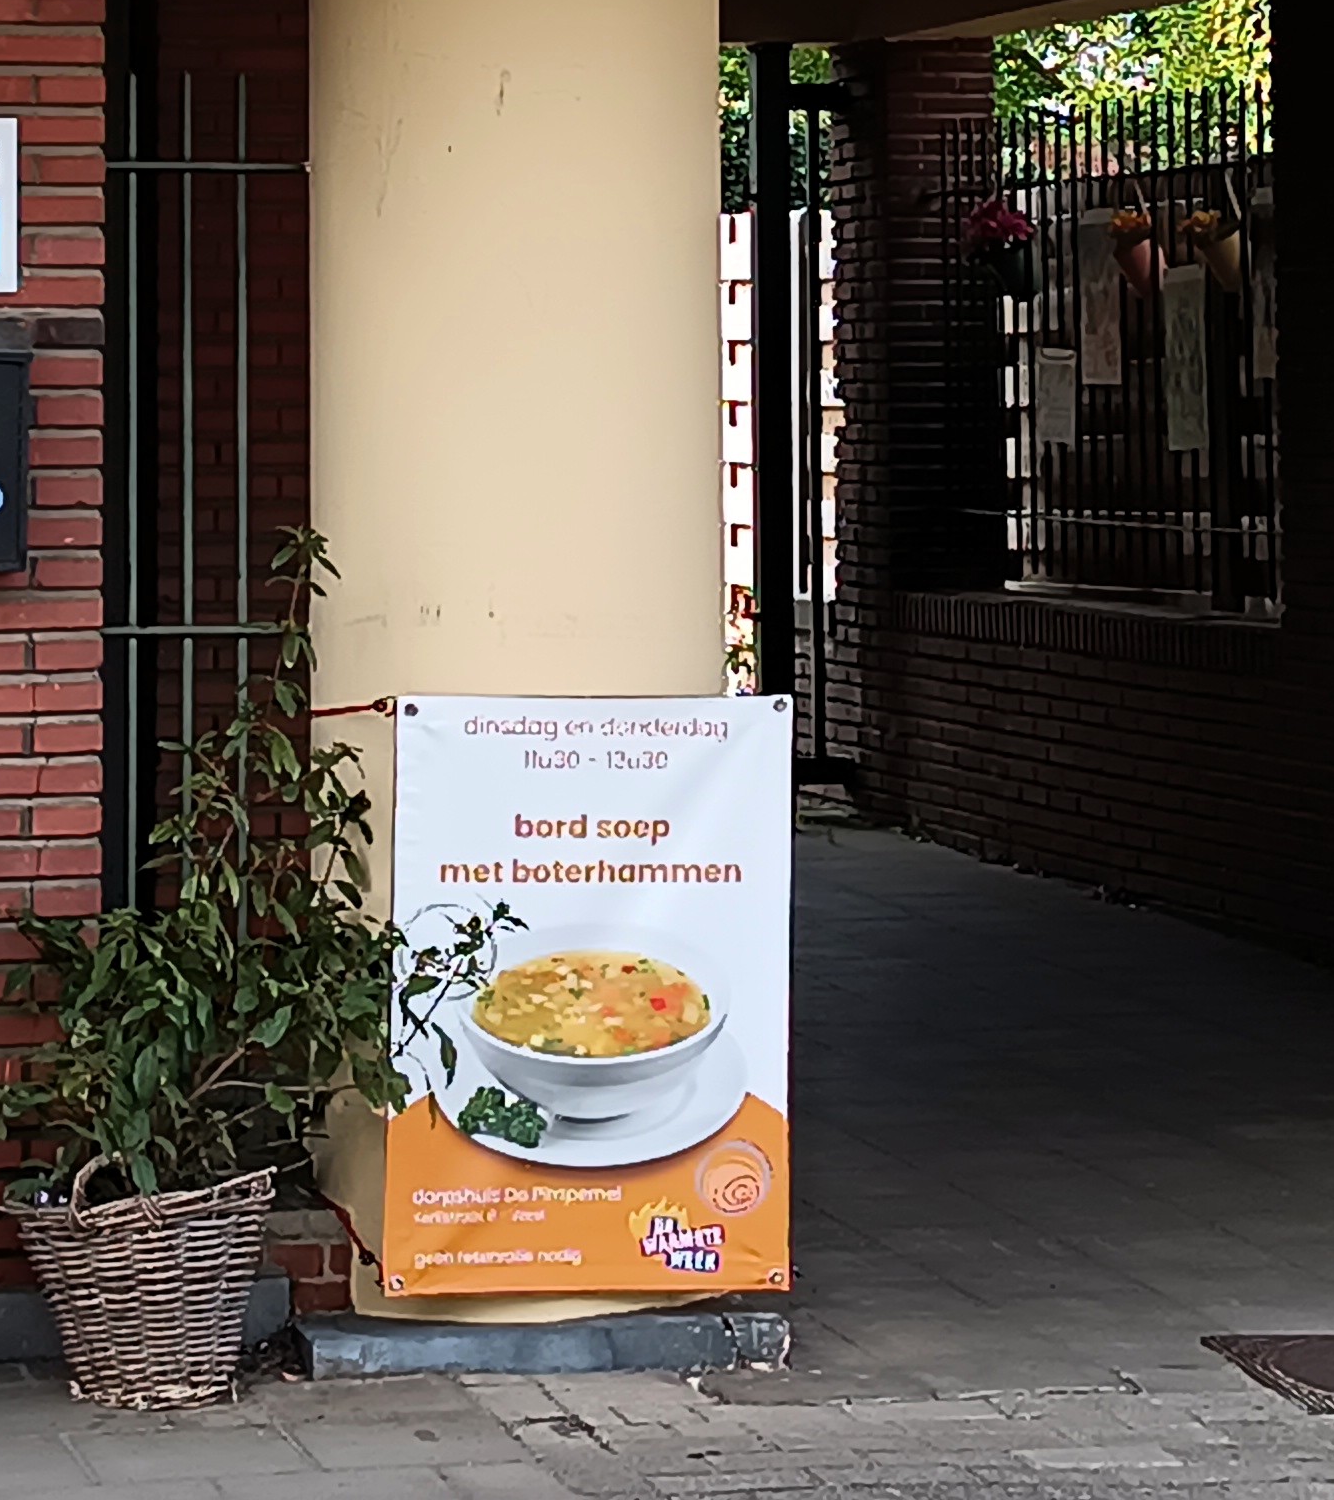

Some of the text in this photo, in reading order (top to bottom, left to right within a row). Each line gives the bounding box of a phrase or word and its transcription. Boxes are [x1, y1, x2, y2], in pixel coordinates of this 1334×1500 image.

[463, 715, 729, 742] dinsdag en donderdag
[523, 749, 581, 770] 11u30
[514, 812, 671, 846] bord soep
[439, 858, 743, 884] met boterhammen
[411, 1187, 501, 1207] dorpshuis
[531, 1185, 622, 1206] Pimpernel
